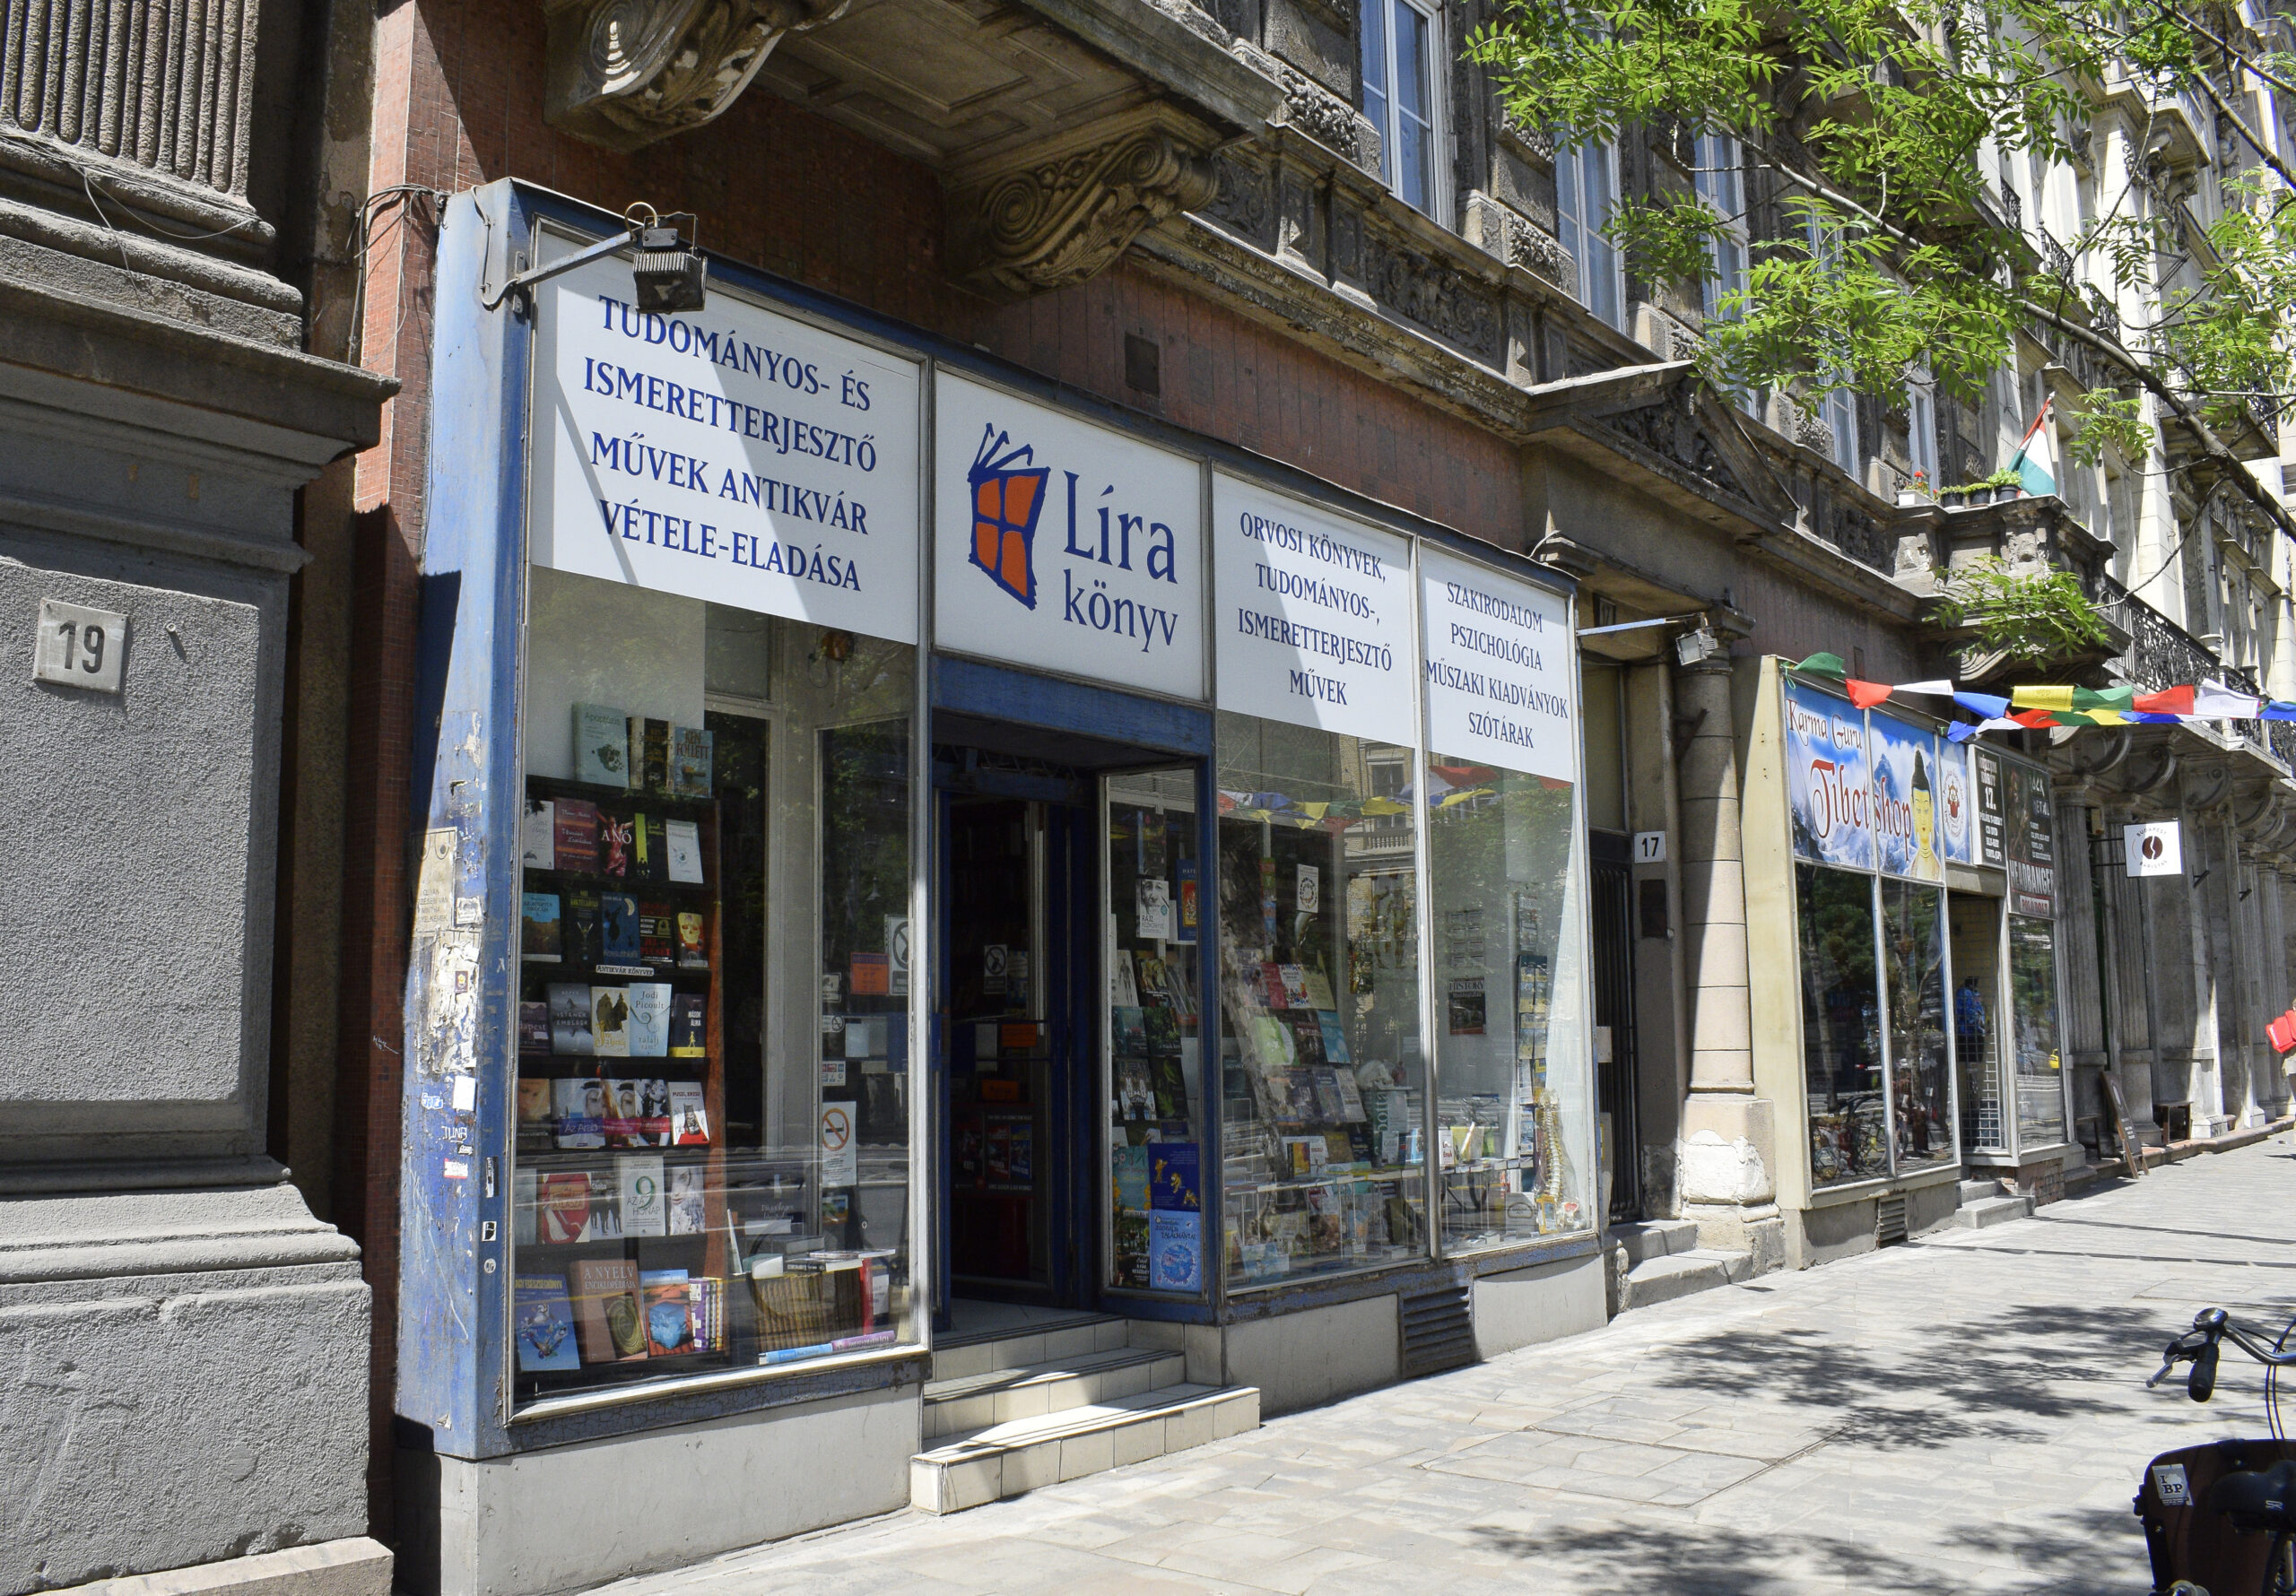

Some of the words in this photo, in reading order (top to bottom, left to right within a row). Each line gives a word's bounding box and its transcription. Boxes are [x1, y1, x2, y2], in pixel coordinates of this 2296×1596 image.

[598, 294, 831, 395] TUDOMÁNYOS-
[840, 370, 871, 412] ÉS
[583, 357, 877, 473] ISMERETTERJESZTŐ
[591, 431, 709, 494] MŰVEK
[718, 468, 869, 535] ANTIKVÁR
[598, 498, 861, 592] VÉTELE-ELADÁSA
[1063, 470, 1178, 584] Líra
[1240, 512, 1303, 553] ORVOSI
[1309, 533, 1386, 585] KÖNYVEK,
[1063, 568, 1178, 653] könyv
[1447, 582, 1543, 633] SZAKIRODALOM
[58, 620, 105, 673] 19
[1238, 608, 1392, 672] ISMERETTERJESZTŐ
[1450, 622, 1543, 672] PSZICHOLÓGIA
[1290, 669, 1348, 706] MŰVEK
[1425, 658, 1484, 695] MŰSZAKI
[1488, 677, 1569, 719] KIADVÁNYOK
[1468, 711, 1534, 749] SZÓTÁRAK
[1787, 698, 1828, 746] Karma
[1831, 714, 1862, 750] Guru
[1810, 759, 1869, 838] Tibet
[1641, 837, 1659, 856] 17
[597, 966, 626, 974] ANTIKVÁR
[628, 967, 653, 976] KÖNYVEK
[641, 991, 658, 1000] Jodi
[1449, 981, 1484, 990] HISTORY
[636, 1000, 664, 1009] Picoult
[635, 1175, 656, 1209] 9
[585, 1268, 592, 1279] A
[596, 1266, 634, 1279] NYELV
[2162, 1483, 2183, 1494] BP
